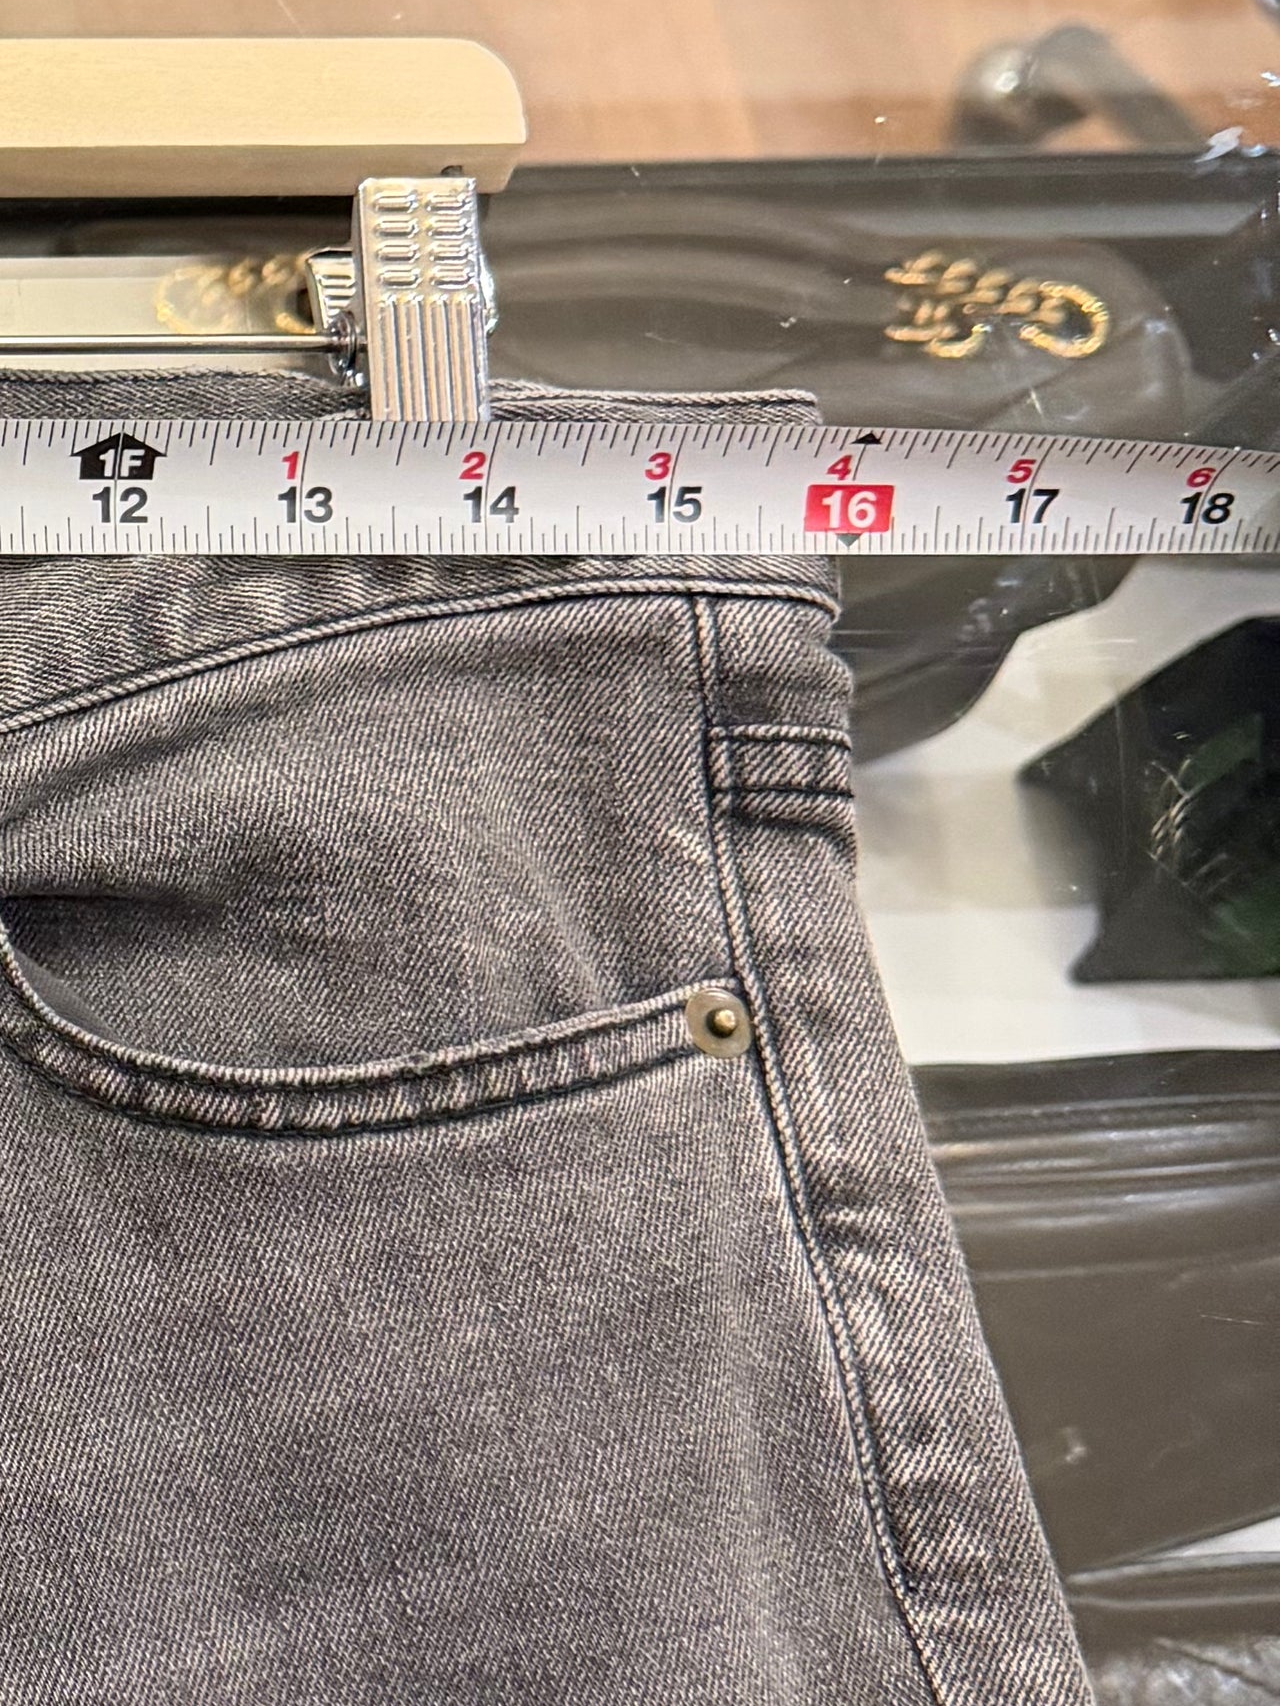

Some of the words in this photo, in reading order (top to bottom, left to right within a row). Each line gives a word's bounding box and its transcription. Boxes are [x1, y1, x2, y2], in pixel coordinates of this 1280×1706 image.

[98, 448, 144, 478] 1F
[282, 452, 300, 480] 1
[459, 452, 487, 480] 2
[644, 452, 671, 481] 3
[827, 454, 852, 481] 4
[1006, 457, 1034, 484] 5
[1186, 466, 1216, 488] 6
[91, 486, 148, 524] 12
[277, 486, 335, 524] 13
[462, 487, 520, 524] 14
[646, 487, 703, 524] 15
[821, 490, 877, 528] 16
[1004, 487, 1059, 524] 17
[1179, 490, 1235, 525] 18
